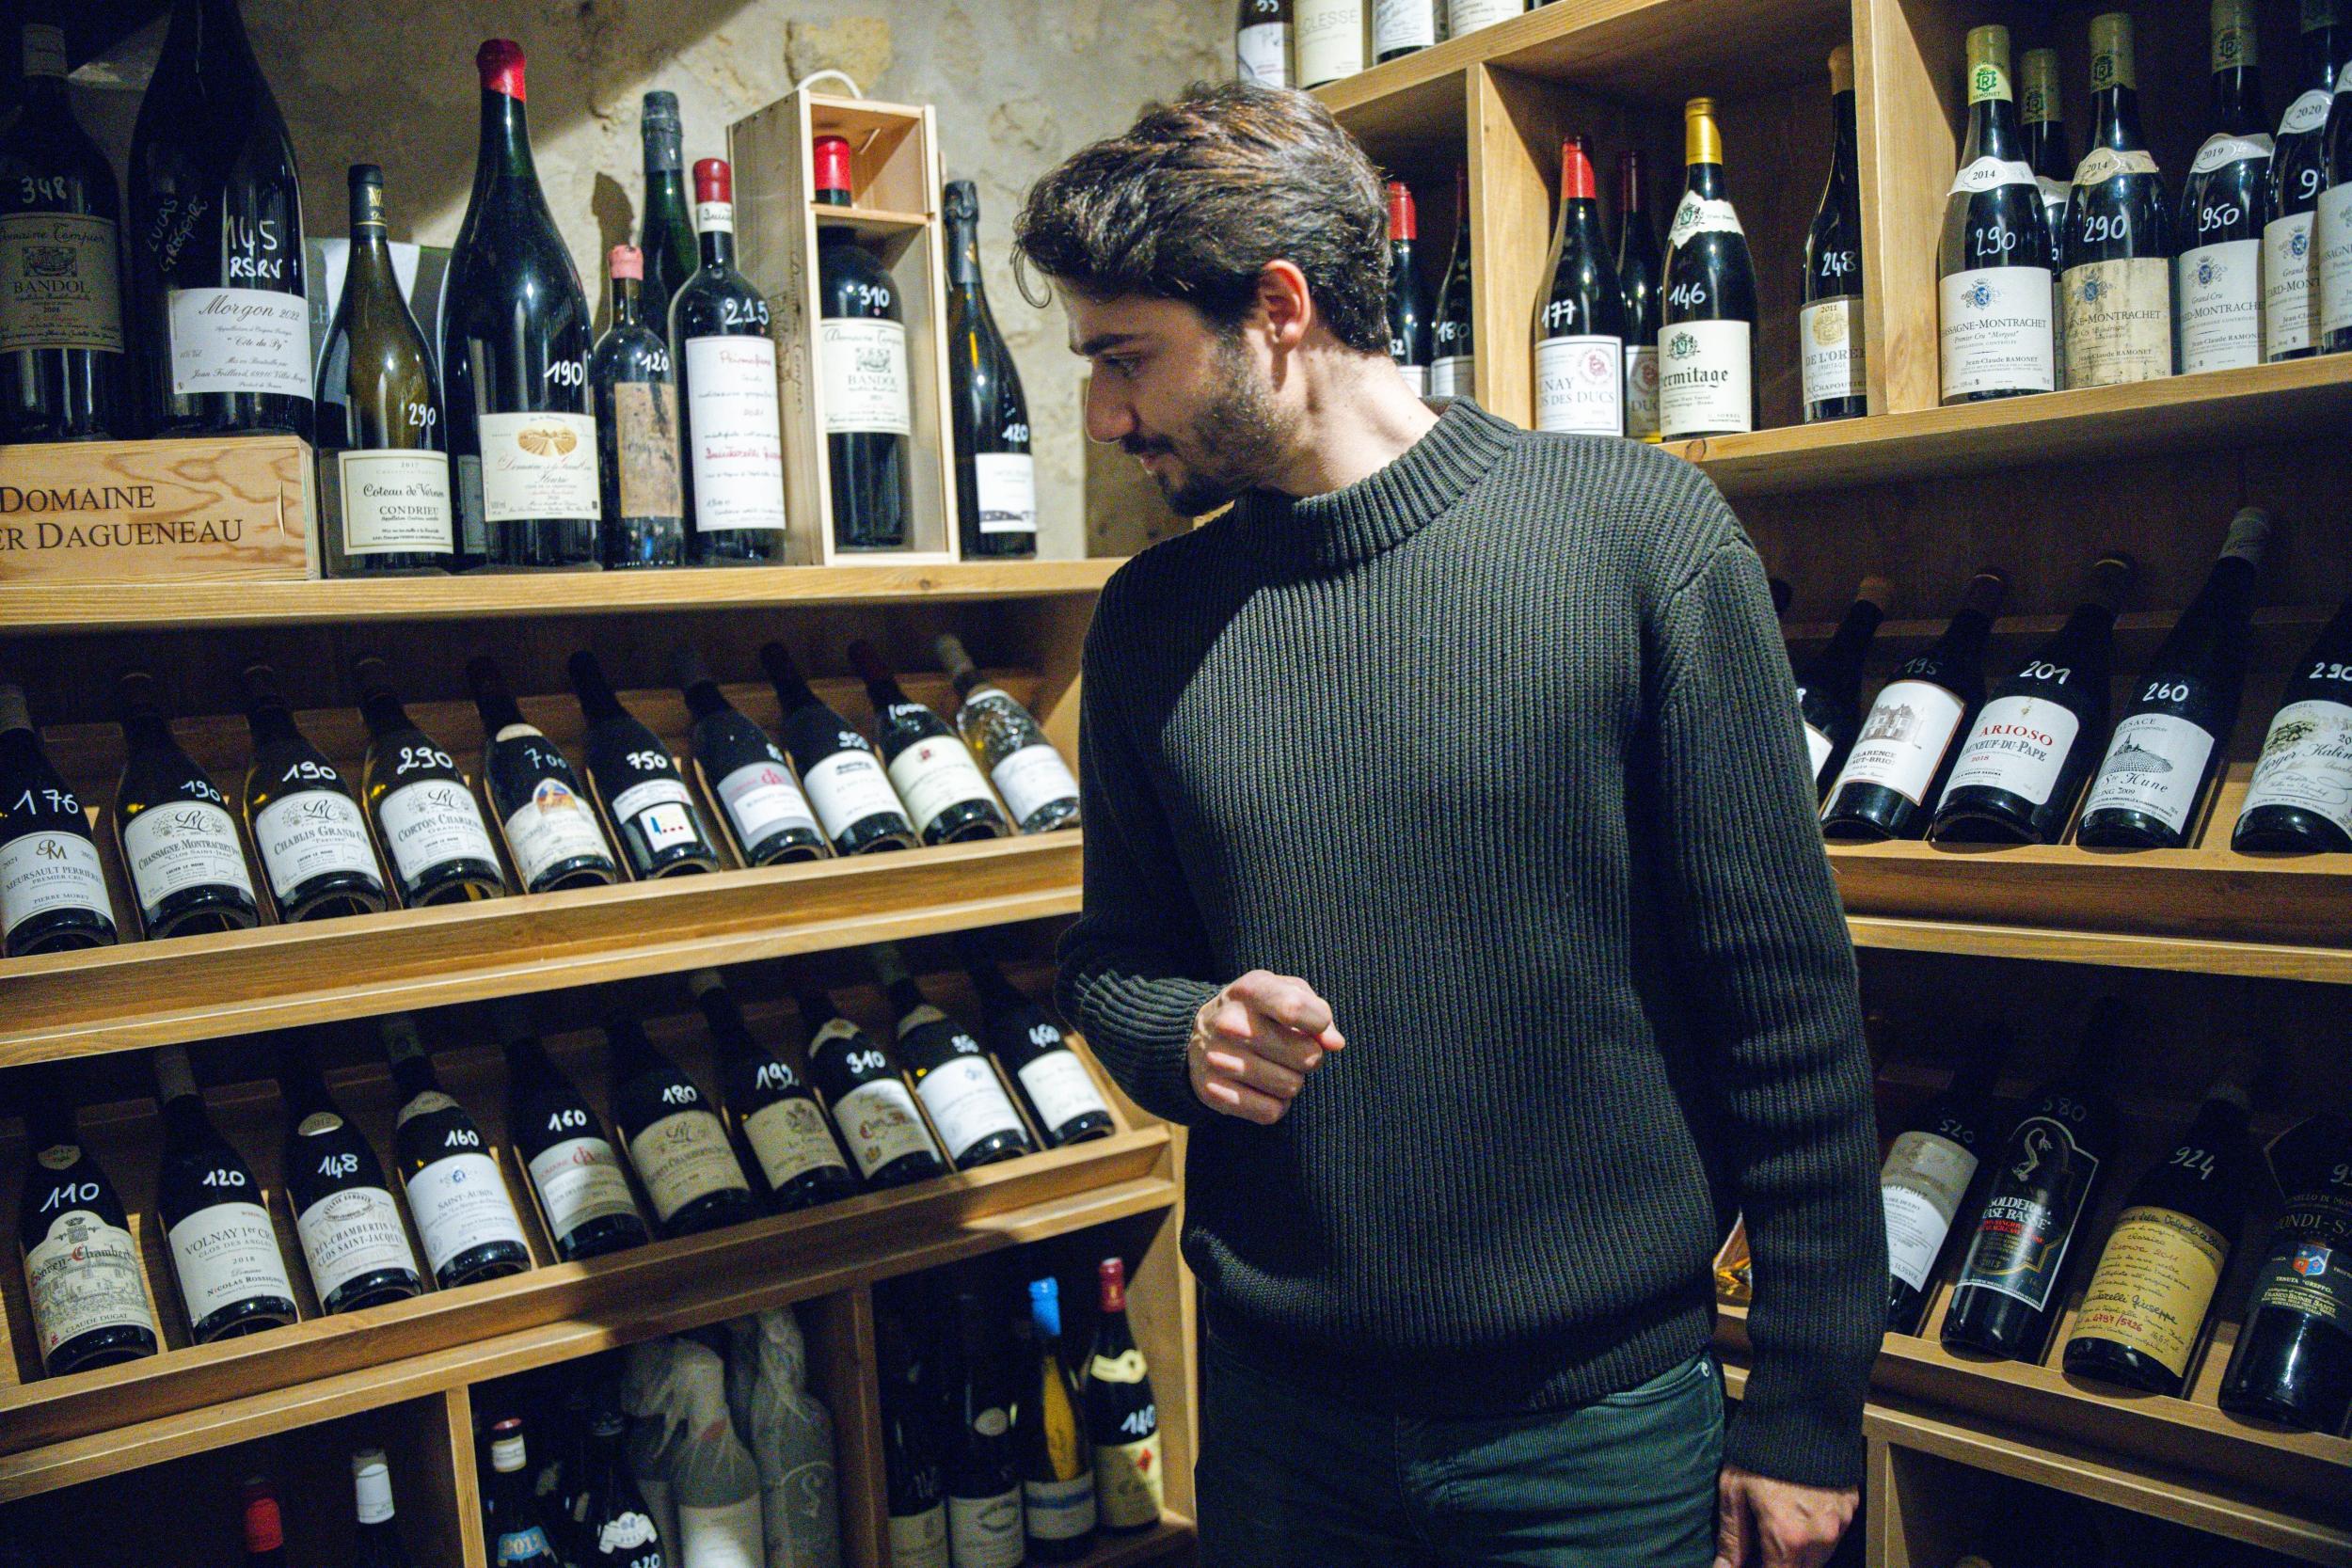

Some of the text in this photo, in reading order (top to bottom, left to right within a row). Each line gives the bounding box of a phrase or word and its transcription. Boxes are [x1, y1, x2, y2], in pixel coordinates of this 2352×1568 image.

[1972, 169, 1996, 180] 2014
[21, 175, 67, 204] 348
[2199, 202, 2239, 231] 950
[2084, 215, 2127, 243] 290
[1976, 227, 2016, 256] 290
[1820, 251, 1857, 277] 248
[858, 284, 890, 308] 310
[1668, 282, 1706, 309] 146
[198, 294, 274, 322] Morgon
[724, 298, 770, 325] 215
[1542, 299, 1576, 328] 177
[2228, 332, 2260, 341] RAMON
[641, 354, 669, 372] 120
[1964, 357, 2005, 367] Jean-Claude
[2116, 348, 2152, 356] RAMONET
[544, 359, 583, 386] 190
[1541, 377, 1574, 392] NAY
[1662, 366, 1729, 388] ermitage
[408, 402, 437, 427] 290
[0, 485, 156, 514] DOMAINE
[363, 482, 404, 498] Coteau
[406, 483, 417, 497] de
[379, 504, 439, 516] CONDRIEU
[37, 519, 243, 550] DAGUENEAU
[2142, 682, 2189, 702] 260
[1979, 723, 2053, 746] ARIOSO
[282, 760, 337, 782] 190
[396, 747, 453, 775] 290
[626, 751, 668, 770] 750
[181, 780, 221, 801] 190
[2120, 772, 2169, 793] Hune
[274, 825, 357, 856] CHABLIS GRAND
[398, 816, 437, 843] CORTON
[138, 843, 182, 871] CHASSAGNE
[6, 866, 61, 893] MEURSAULT
[32, 874, 67, 885] PREMIER
[34, 894, 60, 904] PIERRE
[548, 1109, 587, 1132] 160
[444, 1130, 480, 1148] 160
[318, 1153, 358, 1179] 148
[2169, 1146, 2215, 1180] 924
[202, 1168, 245, 1187] 120
[40, 1182, 99, 1213] 110
[184, 1227, 238, 1256] VOLNAY
[199, 1244, 221, 1259] CLOS
